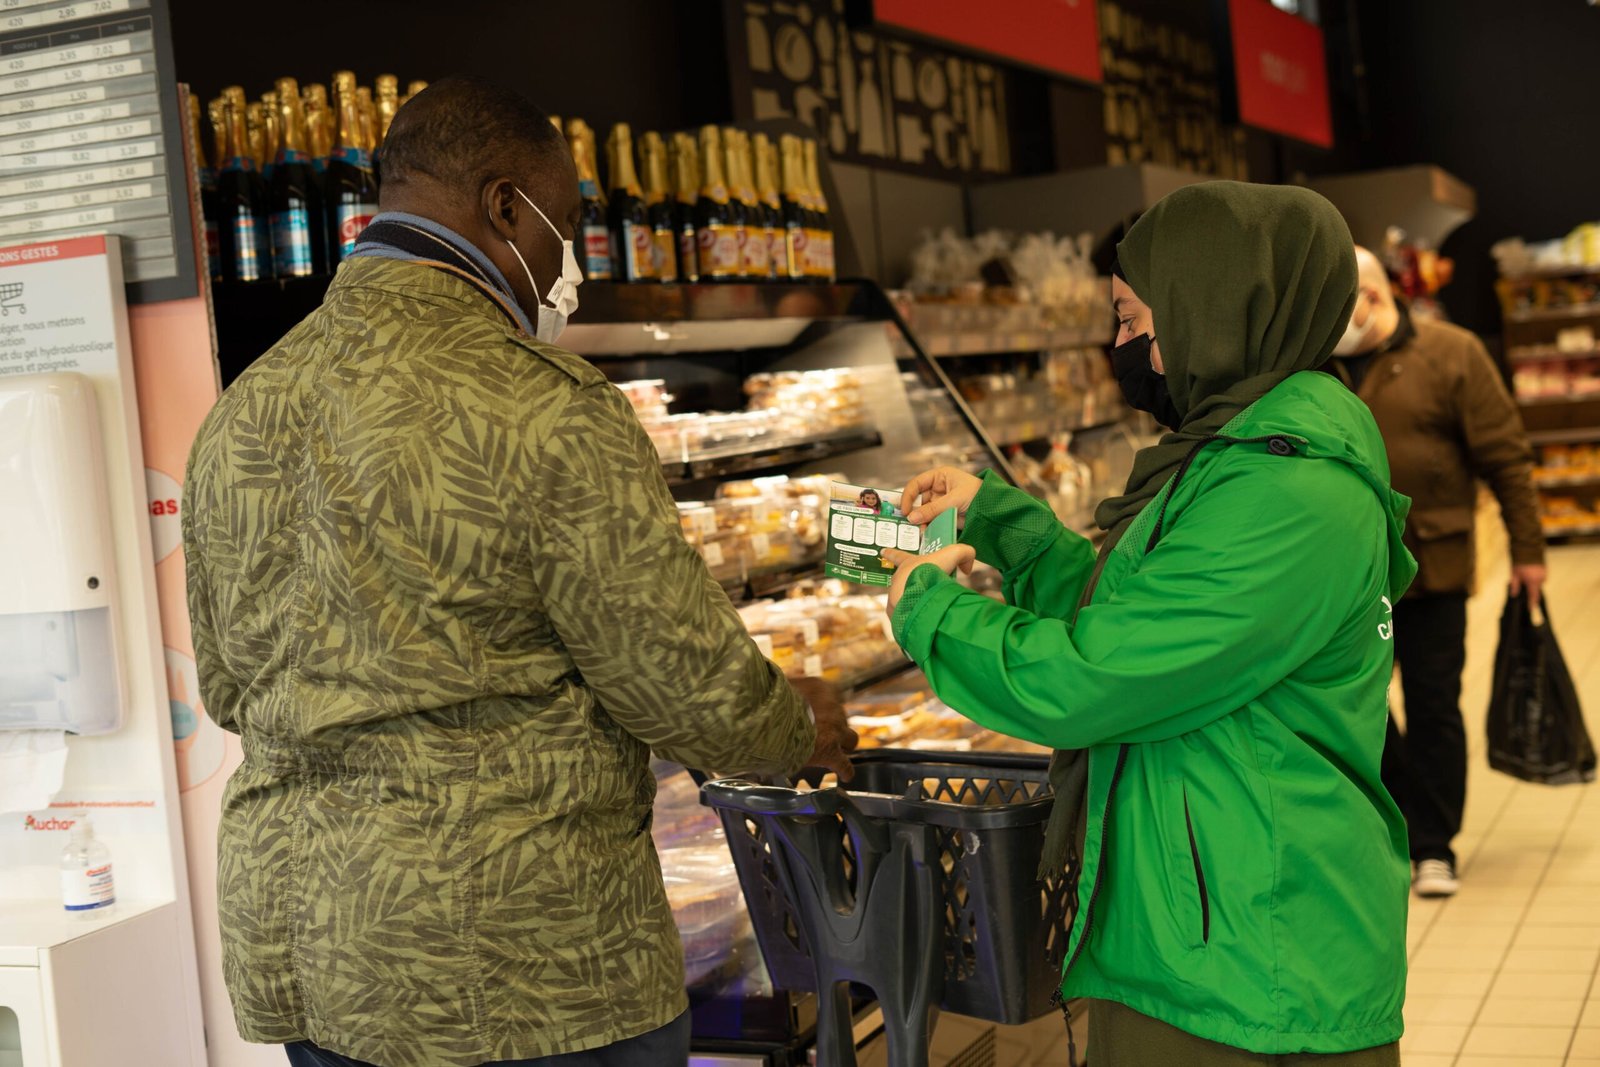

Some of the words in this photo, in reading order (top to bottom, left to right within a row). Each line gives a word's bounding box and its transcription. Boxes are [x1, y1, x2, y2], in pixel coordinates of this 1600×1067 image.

[8, 18, 23, 27] 420
[59, 9, 76, 19] 2,95
[94, 1, 112, 11] 7,02
[9, 60, 24, 70] 420
[60, 51, 77, 62] 2,95
[21, 245, 59, 260] GESTES
[23, 321, 45, 330] nous
[47, 317, 86, 328] mettons
[10, 349, 22, 360] du
[24, 347, 38, 361] gel
[40, 341, 114, 359] hydroalcoolique
[26, 362, 36, 371] et
